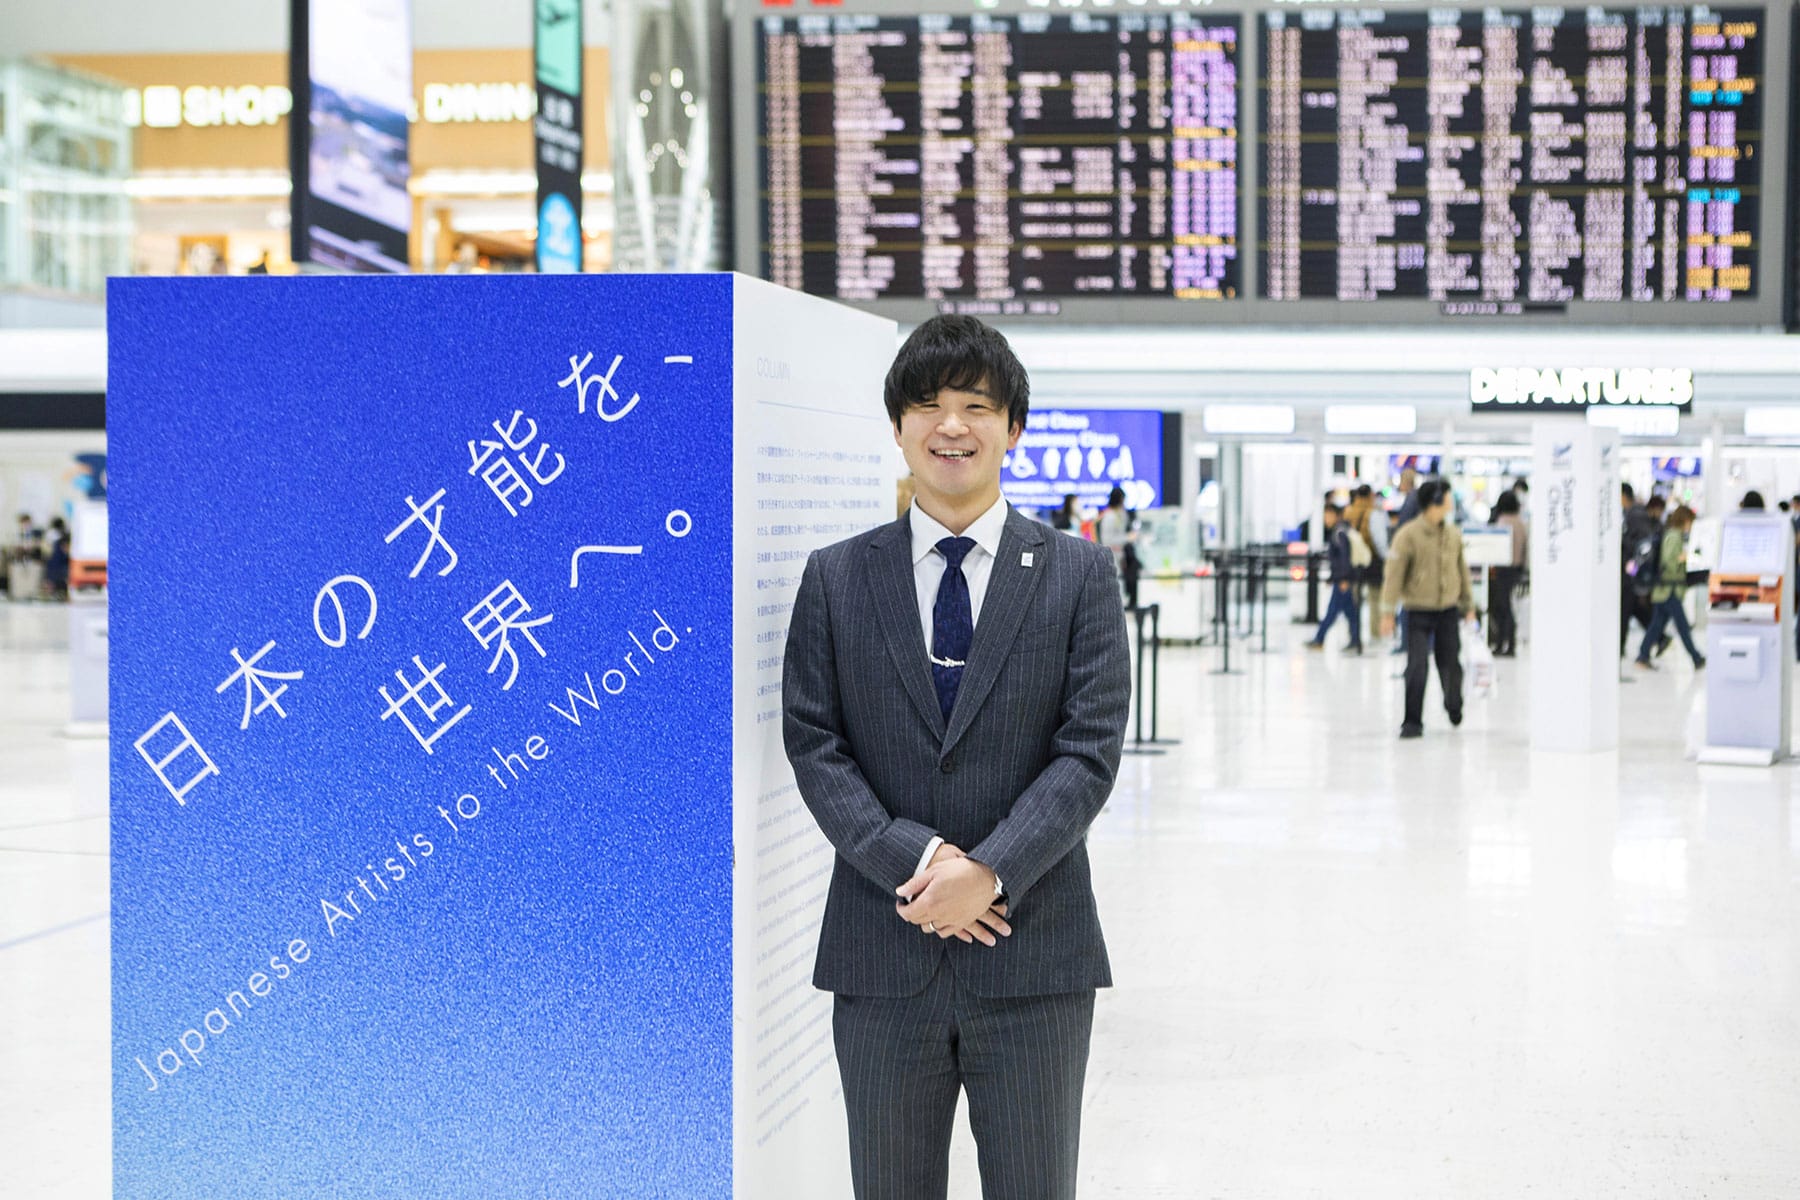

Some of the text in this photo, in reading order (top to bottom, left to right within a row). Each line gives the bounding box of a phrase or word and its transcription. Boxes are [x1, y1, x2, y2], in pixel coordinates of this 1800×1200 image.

[184, 84, 293, 126] SHOP
[424, 82, 539, 122] DININ
[1470, 367, 1693, 405] DEPARTURES
[378, 509, 693, 755] 世界へ。
[133, 609, 693, 1091] Japanese Artists to the World.
